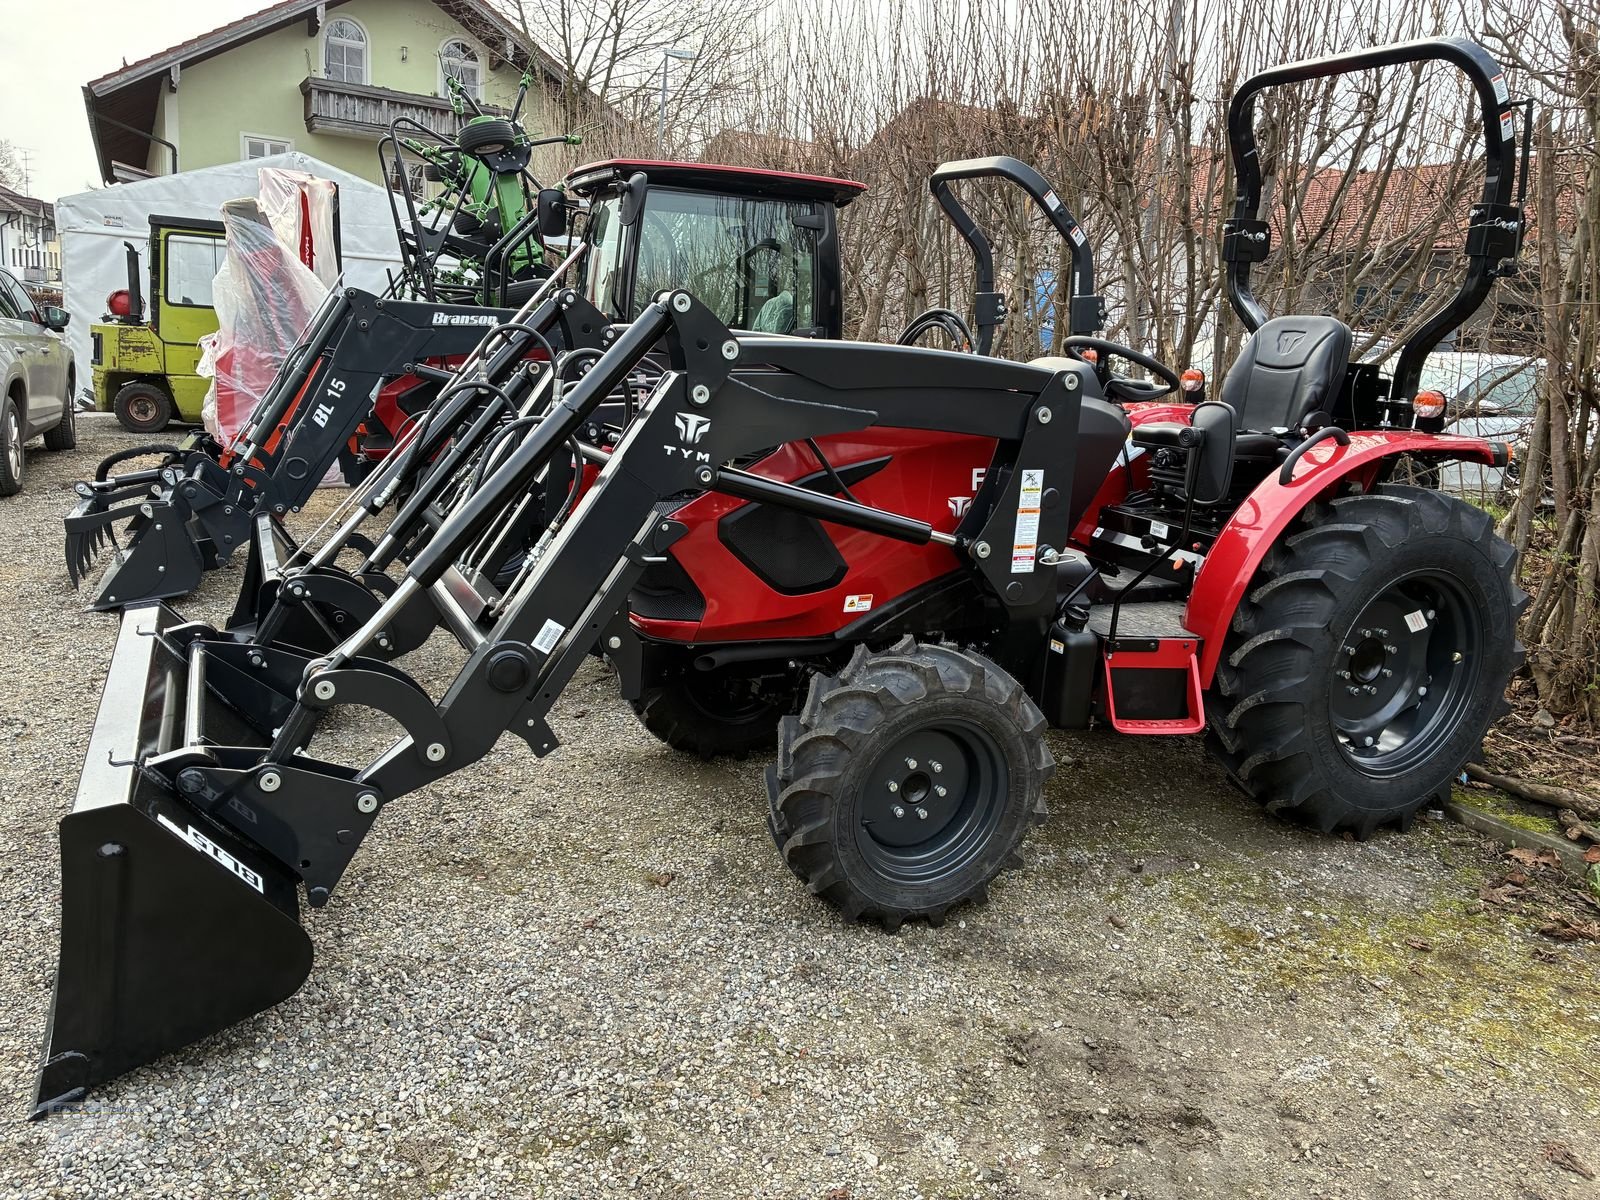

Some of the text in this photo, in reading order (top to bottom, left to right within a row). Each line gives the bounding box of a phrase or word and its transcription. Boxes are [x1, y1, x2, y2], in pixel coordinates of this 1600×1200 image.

[432, 311, 497, 326] Branson
[312, 377, 346, 428] BL 15
[663, 444, 710, 463] TYM
